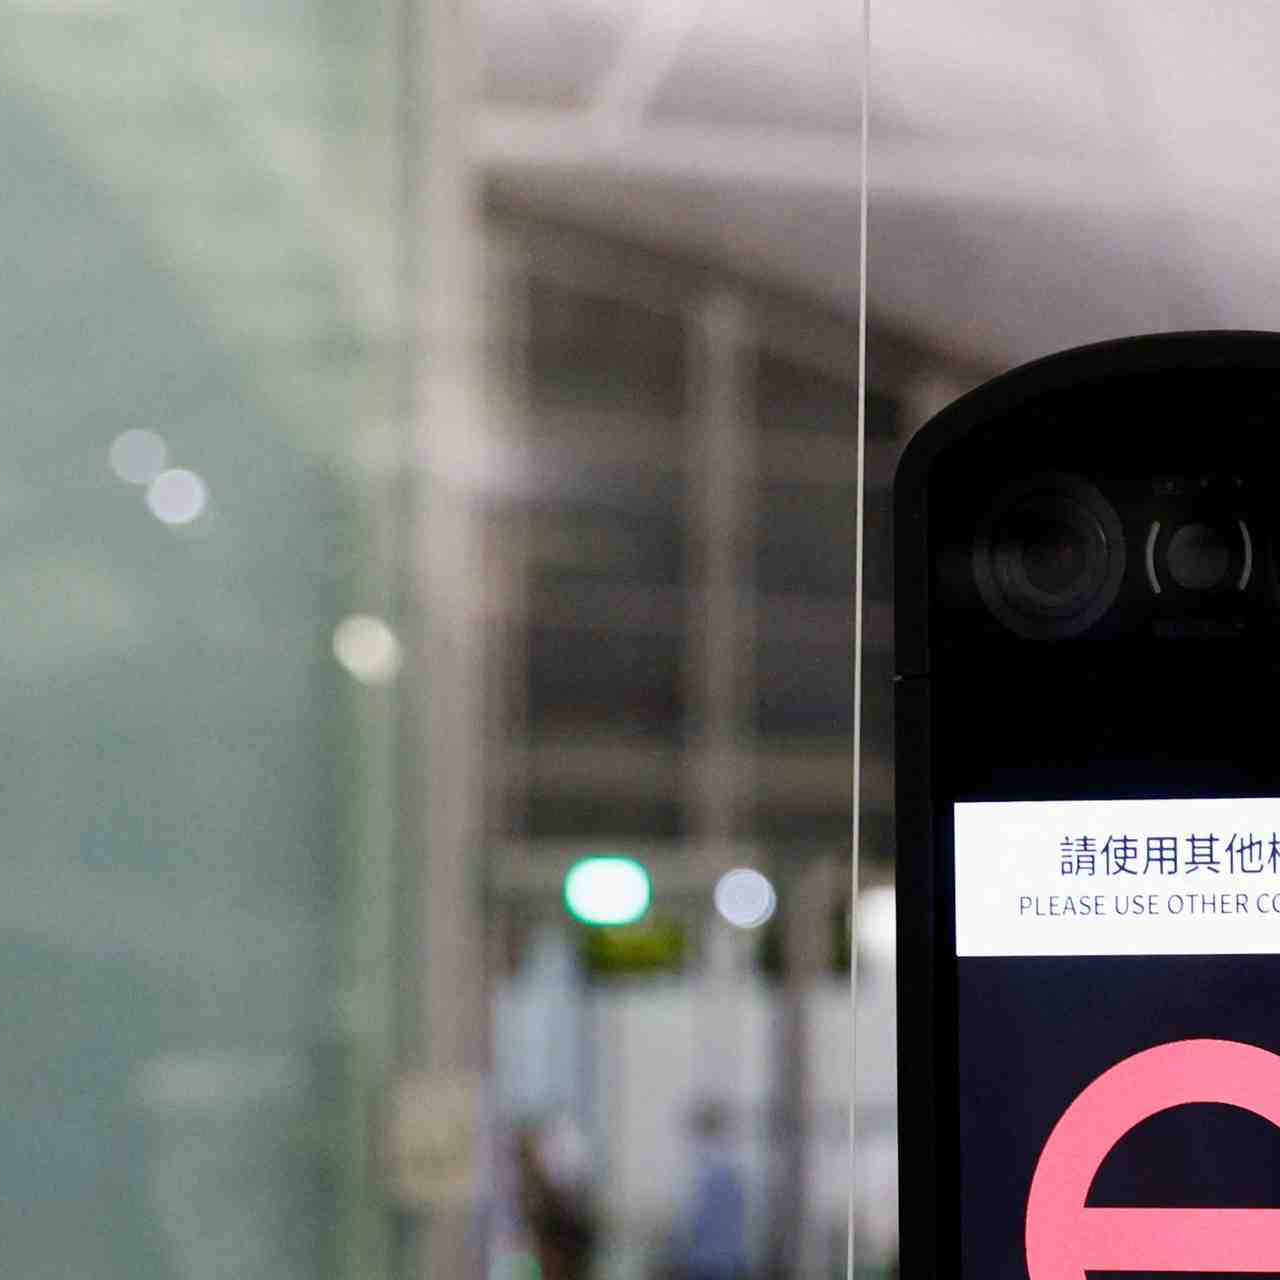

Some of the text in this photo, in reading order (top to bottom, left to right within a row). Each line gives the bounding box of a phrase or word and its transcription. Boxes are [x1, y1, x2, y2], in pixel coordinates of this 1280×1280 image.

[1019, 894, 1106, 917] PLEASE
[1115, 893, 1159, 916] USE
[1167, 892, 1250, 915] OTHER
